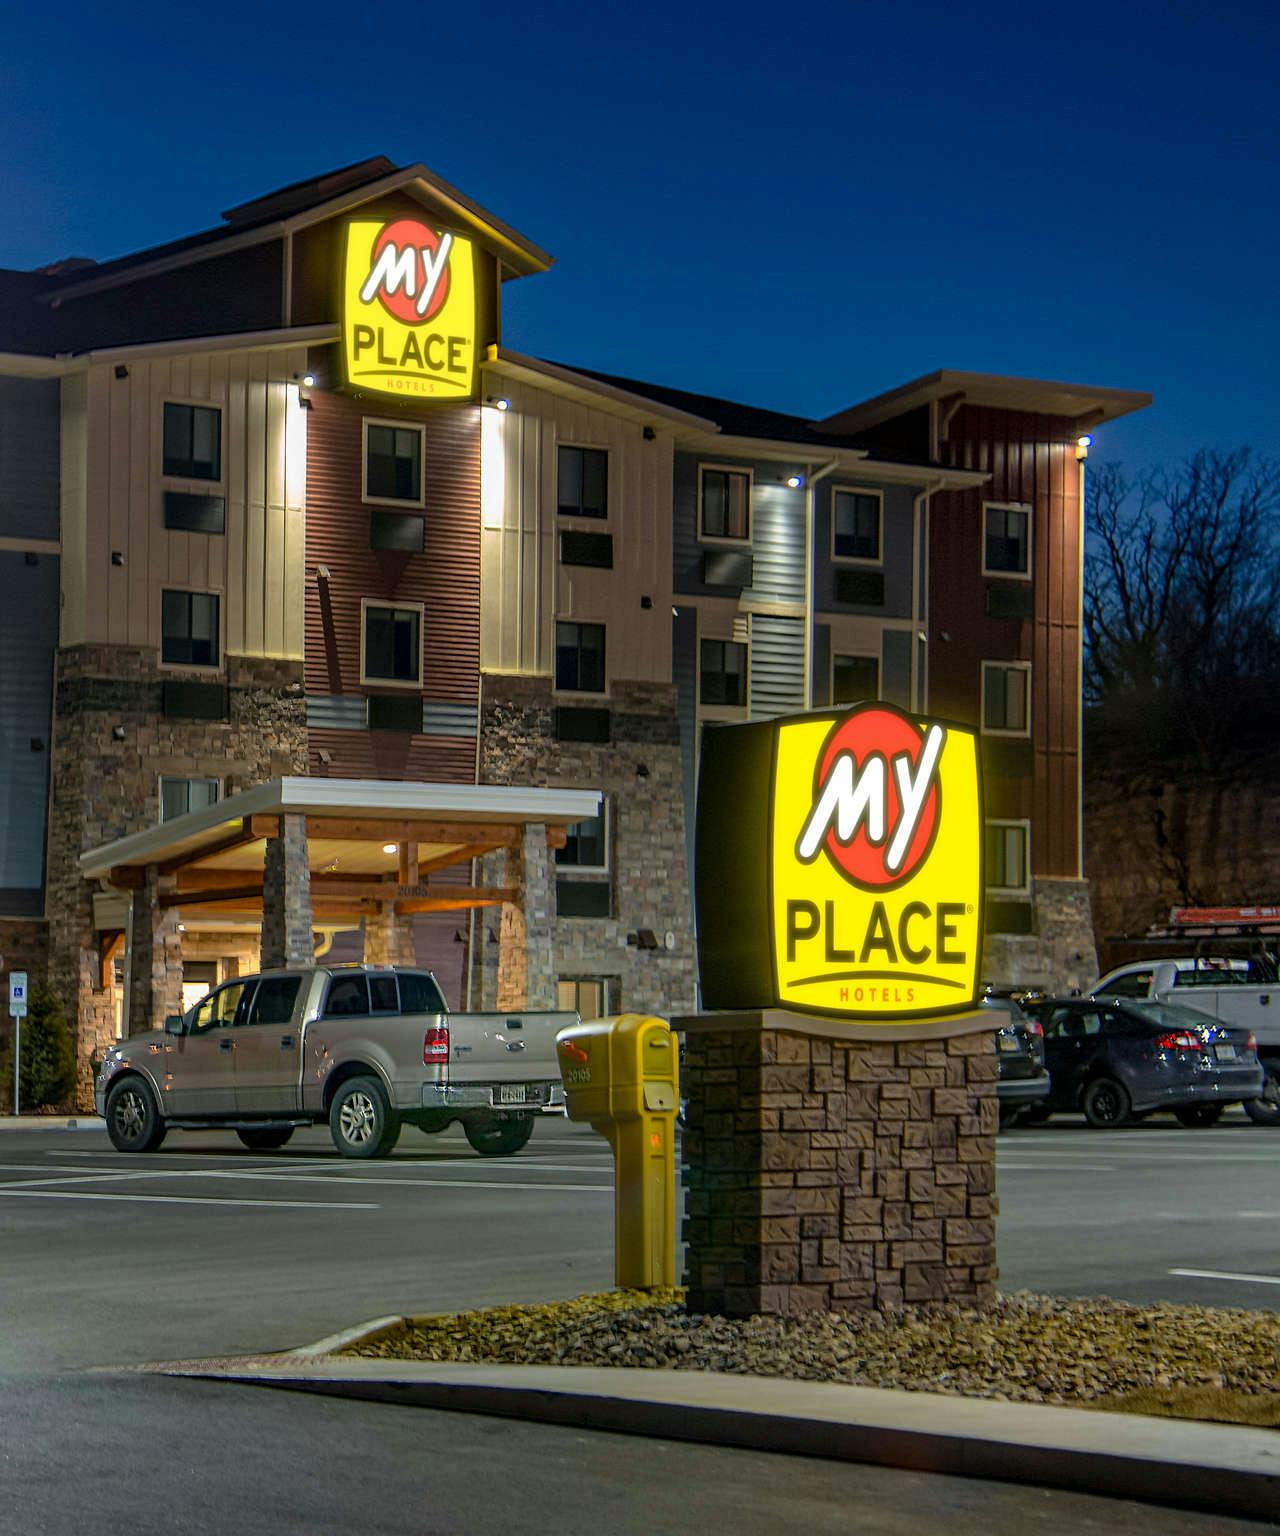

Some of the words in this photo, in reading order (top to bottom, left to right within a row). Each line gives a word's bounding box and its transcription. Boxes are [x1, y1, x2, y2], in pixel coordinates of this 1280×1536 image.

[353, 323, 467, 374] PLACE
[386, 378, 435, 393] HOTELS
[839, 987, 915, 1003] HOTELS
